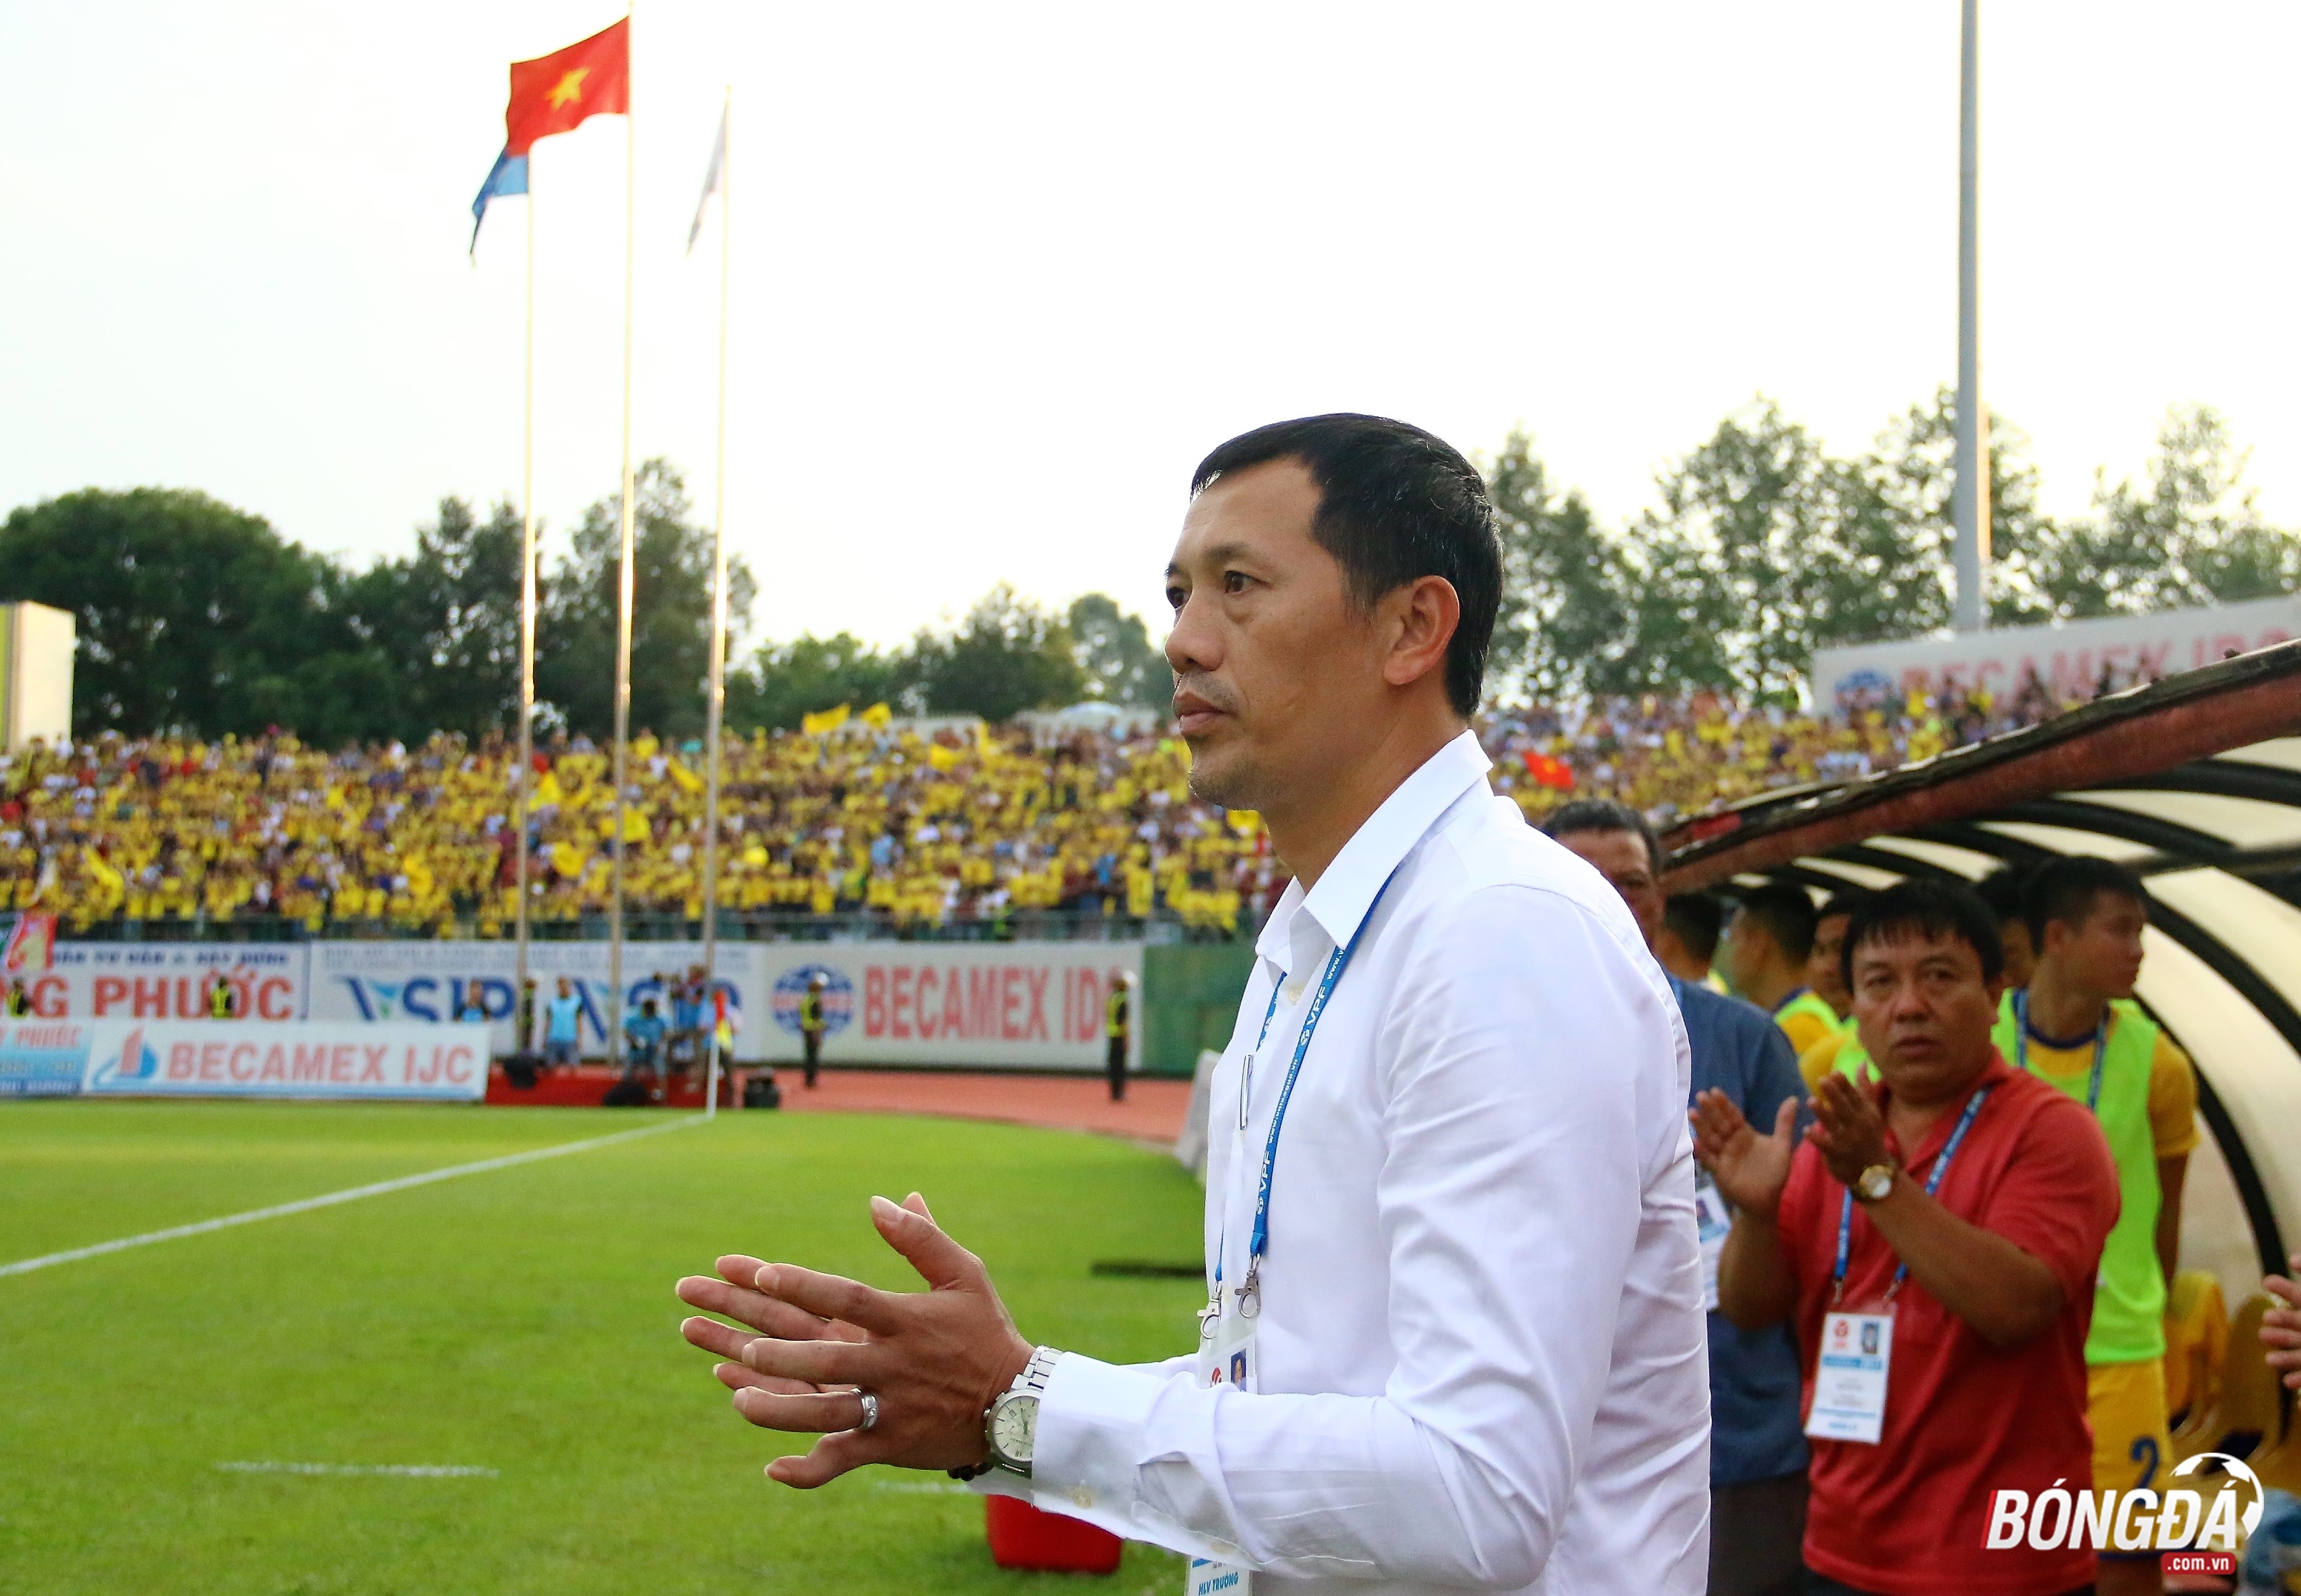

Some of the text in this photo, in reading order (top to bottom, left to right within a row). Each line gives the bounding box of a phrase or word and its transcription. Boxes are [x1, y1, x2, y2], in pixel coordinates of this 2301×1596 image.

[865, 965, 1051, 1042] BECAMEX
[166, 1042, 475, 1084] BECAMEX IJC
[1259, 1150, 1271, 1192] VPF
[1306, 986, 1326, 1026] VPF
